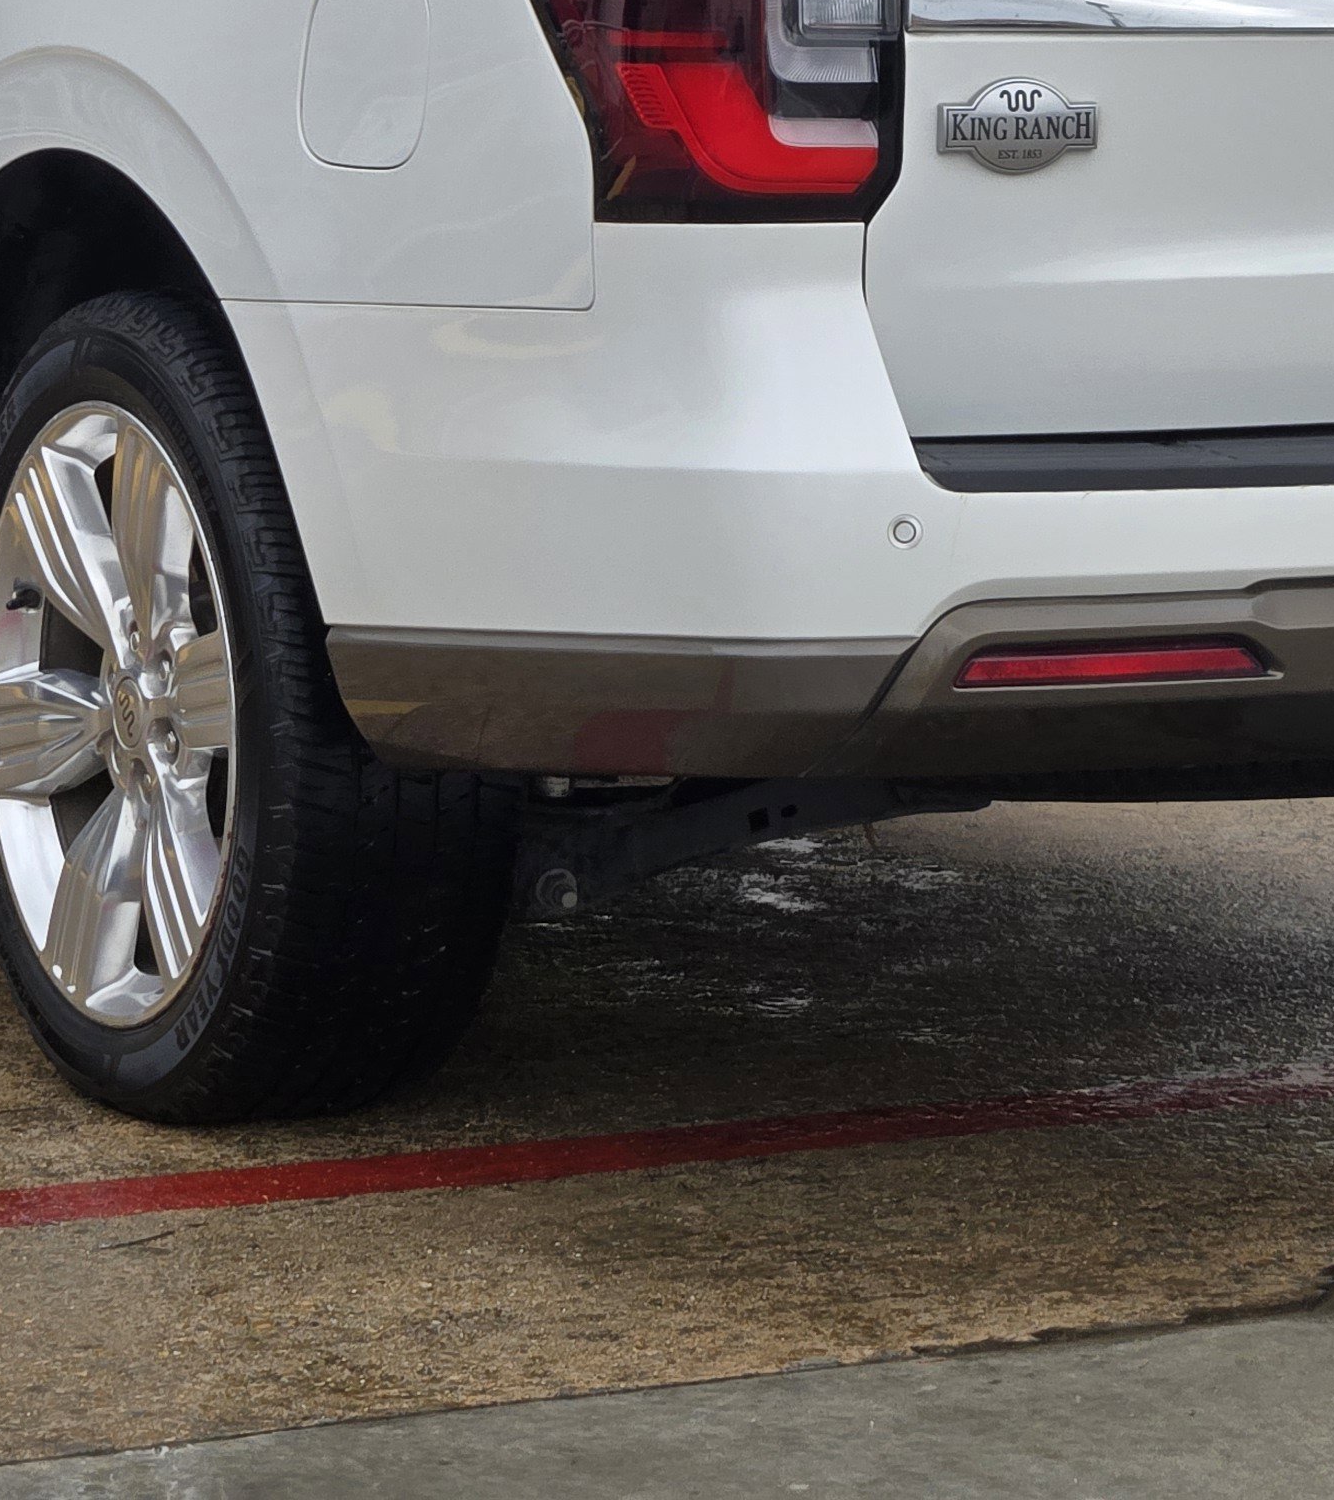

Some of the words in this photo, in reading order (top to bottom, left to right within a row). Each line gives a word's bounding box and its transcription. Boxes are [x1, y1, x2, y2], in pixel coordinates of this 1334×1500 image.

[951, 113, 1008, 141] KING
[1014, 111, 1092, 140] RANCH
[174, 845, 250, 1051] GOODYEAR
